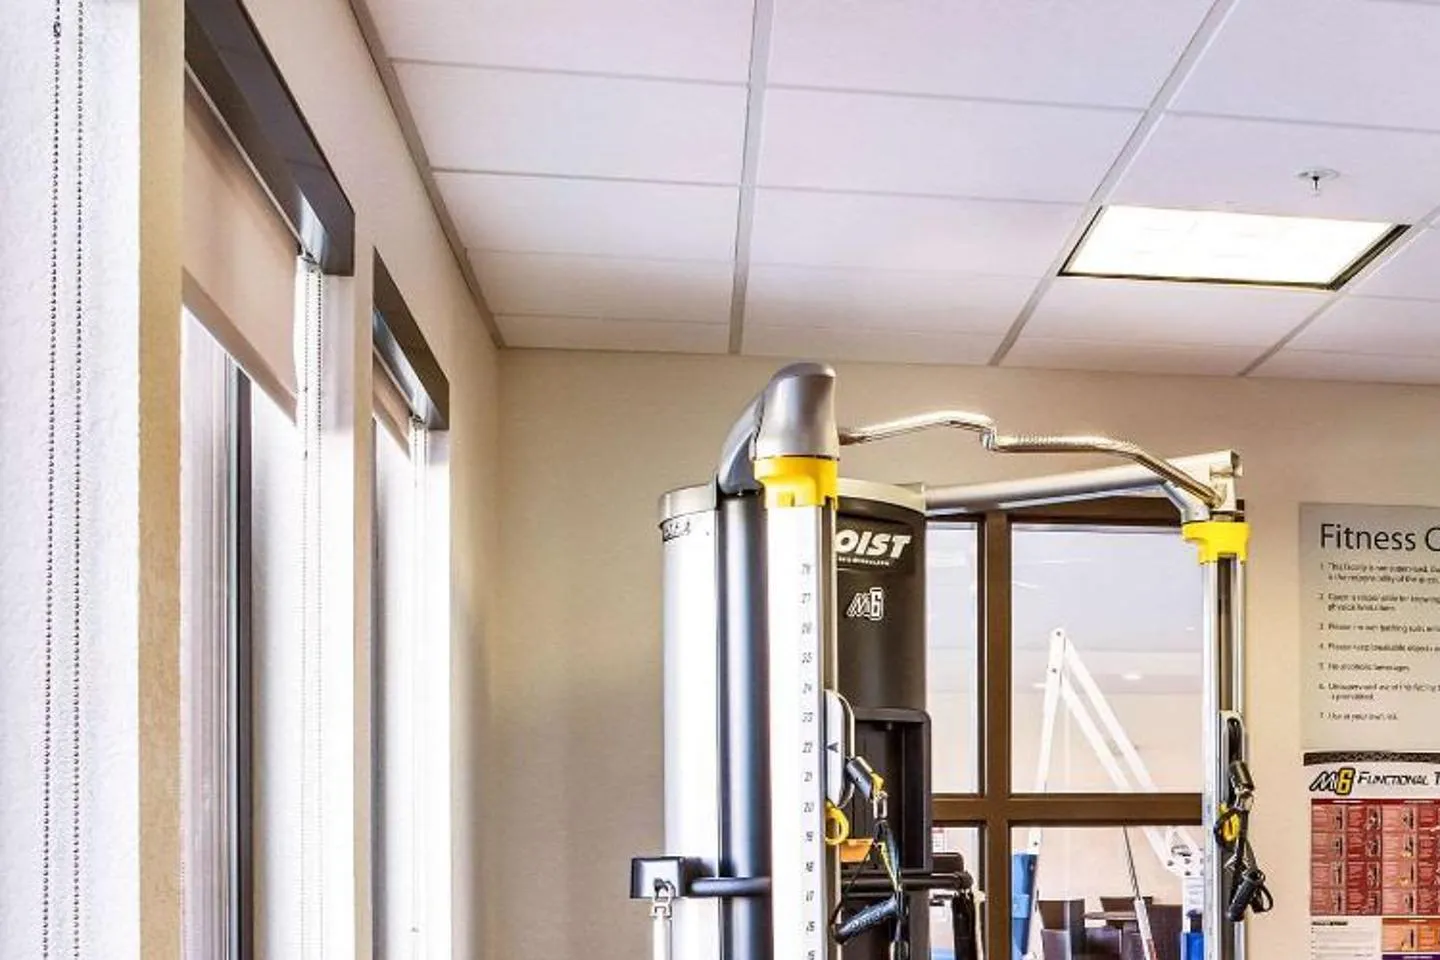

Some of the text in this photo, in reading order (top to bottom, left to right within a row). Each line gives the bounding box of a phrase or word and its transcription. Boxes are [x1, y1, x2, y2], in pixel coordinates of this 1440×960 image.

[836, 529, 912, 559] OIST
[1320, 523, 1417, 551] Fitness
[1309, 767, 1356, 795] M6
[1357, 771, 1429, 785] FUNCTIONAL
